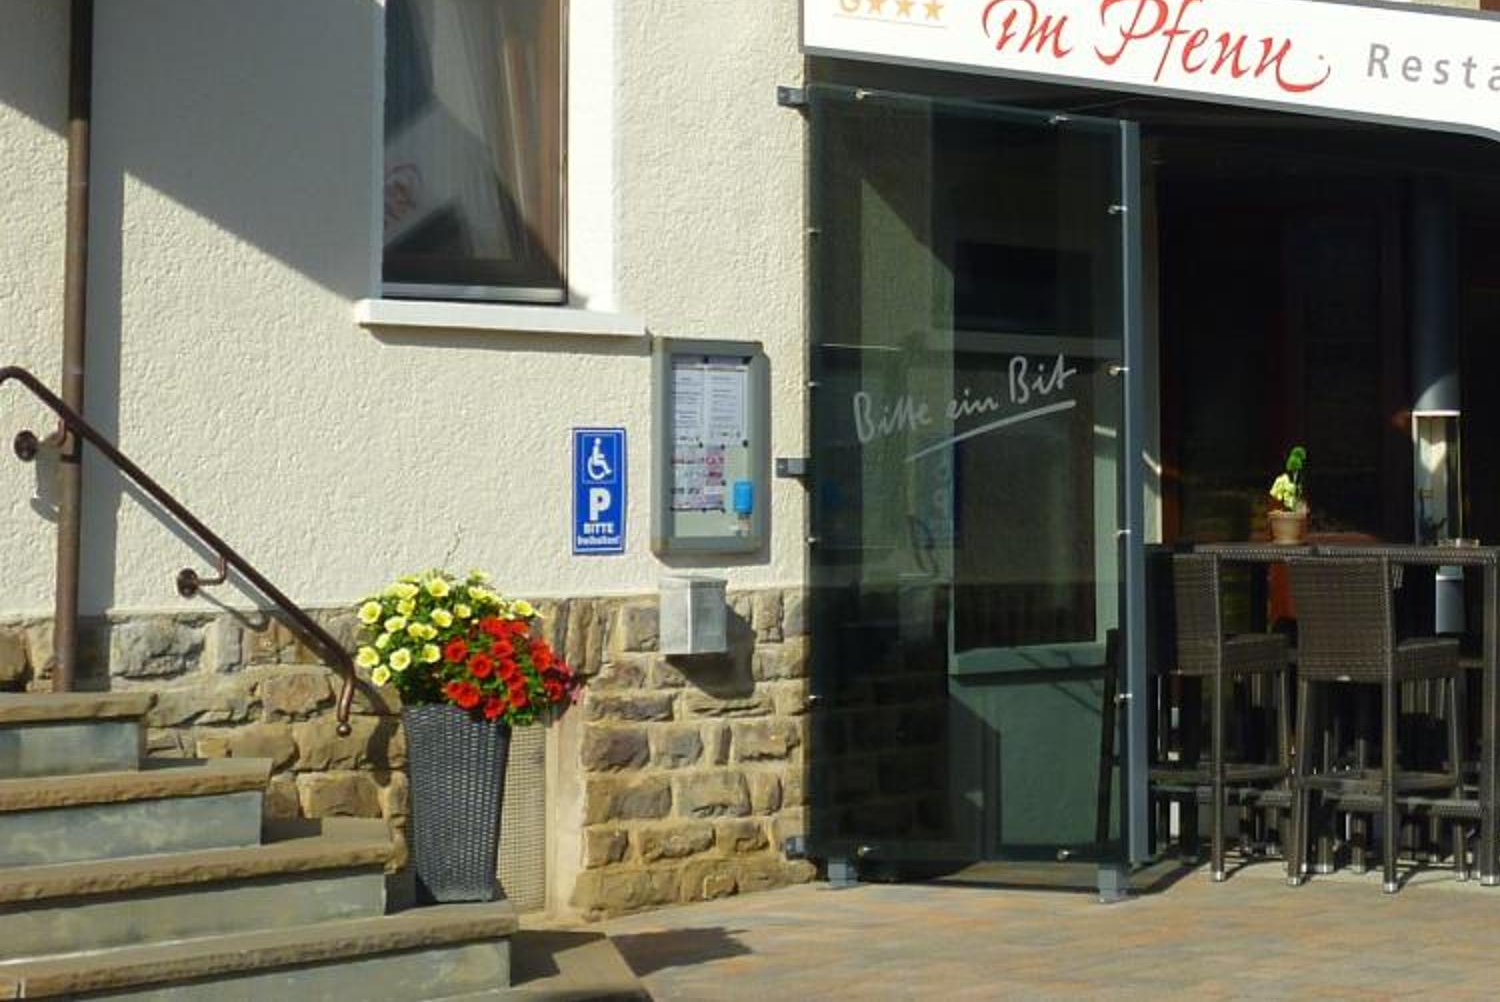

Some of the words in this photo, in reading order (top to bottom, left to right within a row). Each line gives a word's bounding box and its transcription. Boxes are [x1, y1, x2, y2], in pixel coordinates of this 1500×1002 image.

[853, 391, 932, 443] Bitte
[946, 389, 999, 419] ein
[1009, 353, 1077, 404] Bit
[589, 487, 611, 521] P
[583, 522, 615, 535] BITTE
